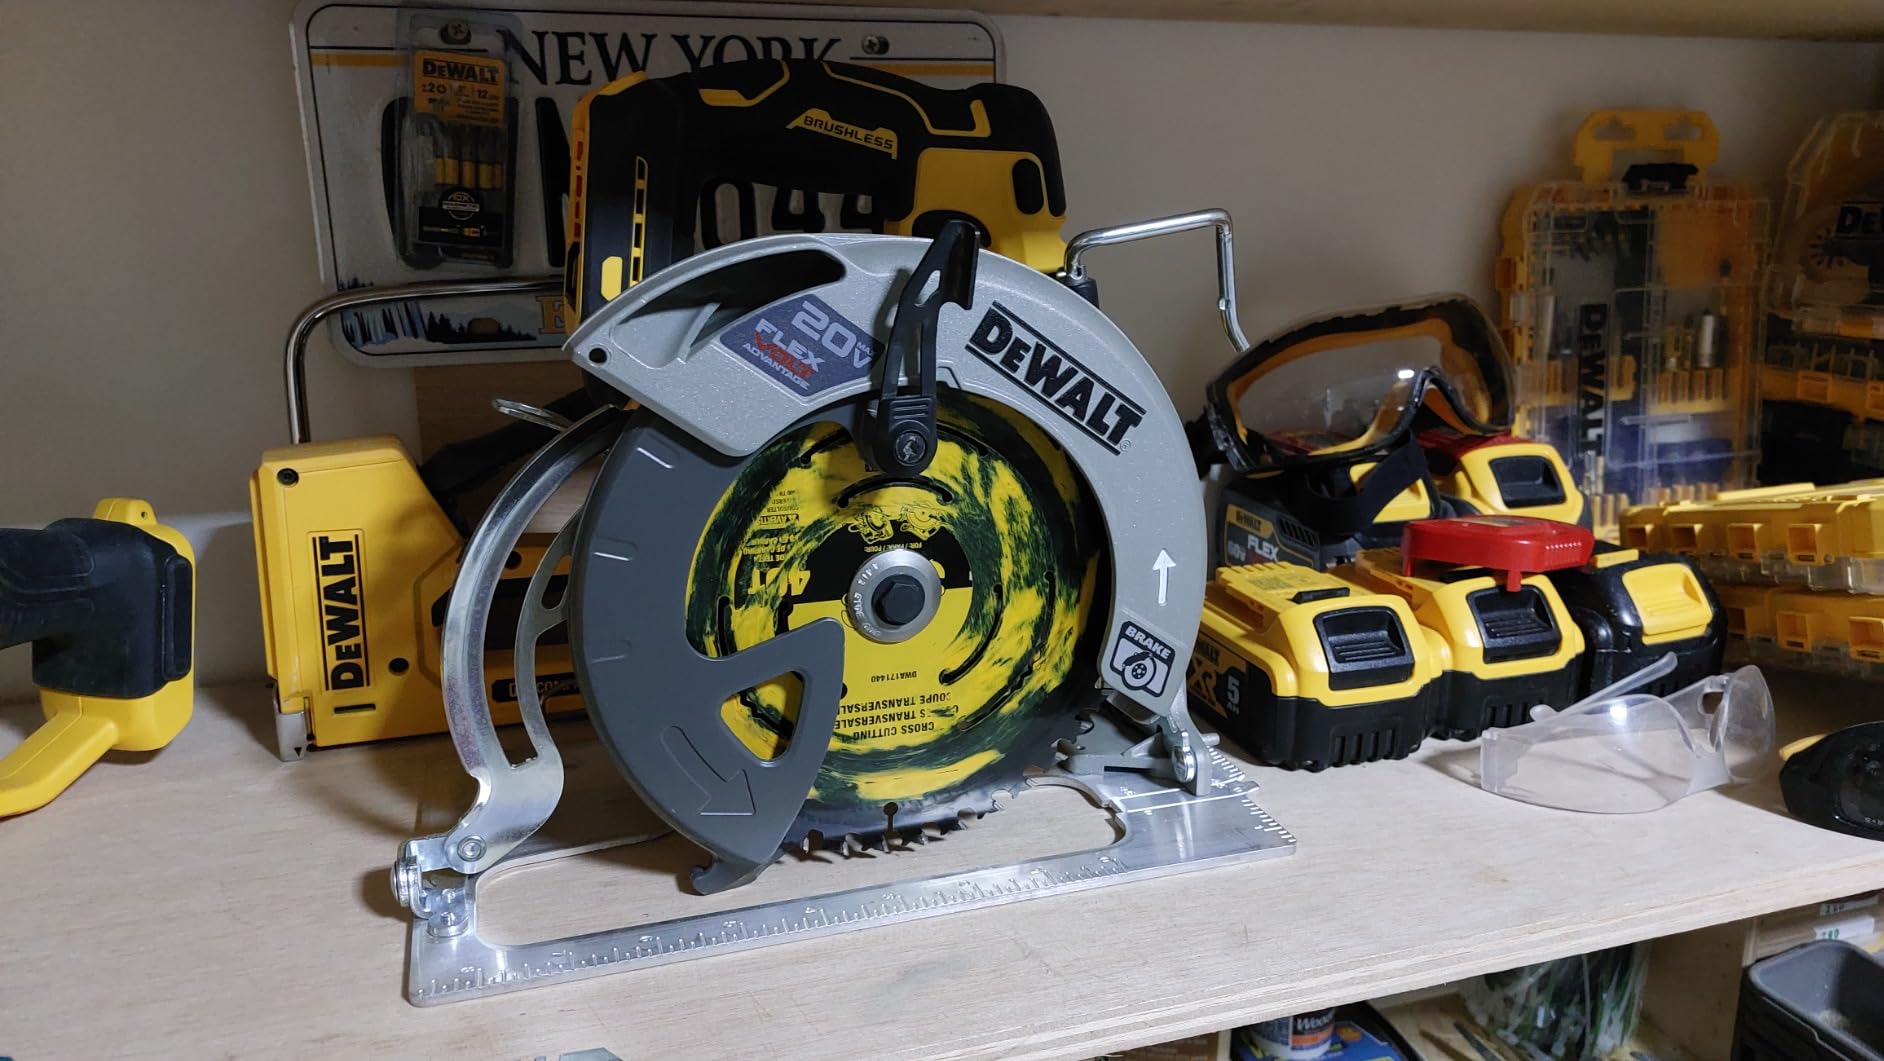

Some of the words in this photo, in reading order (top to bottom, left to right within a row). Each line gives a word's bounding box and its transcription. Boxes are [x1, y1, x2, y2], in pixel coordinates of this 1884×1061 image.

[422, 59, 499, 85] DEWALT
[496, 29, 658, 86] NEW
[803, 115, 894, 150] BRUSHLESS
[754, 318, 826, 373] FLEX
[791, 299, 873, 369] 20V
[742, 343, 811, 391] ADVANTAGE
[968, 305, 1144, 447] DEWALT
[1580, 303, 1608, 457] DEWALT
[1247, 534, 1279, 562] FLEX
[316, 534, 367, 692] DEWALT
[1124, 624, 1172, 660] BRAKE
[870, 670, 917, 683] DWA171440
[1227, 674, 1240, 705] 5
[852, 726, 897, 741] CUTTING
[901, 721, 935, 736] CROSS
